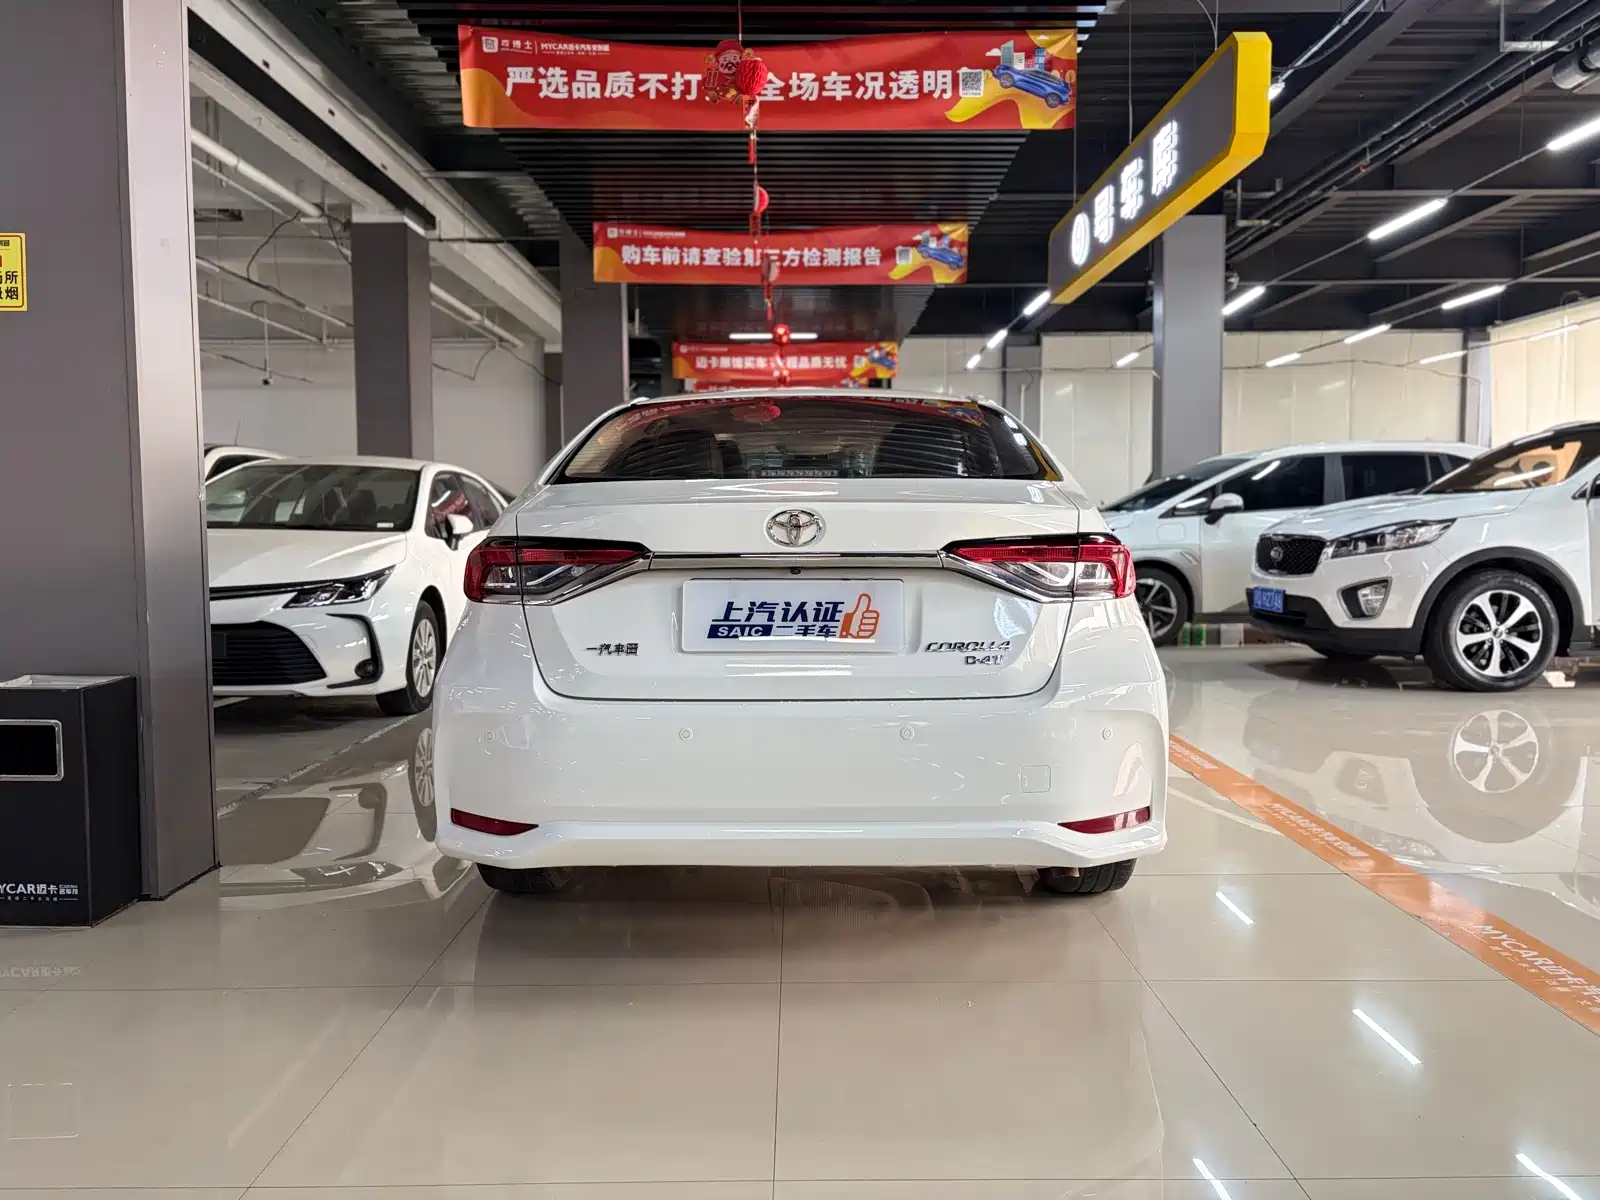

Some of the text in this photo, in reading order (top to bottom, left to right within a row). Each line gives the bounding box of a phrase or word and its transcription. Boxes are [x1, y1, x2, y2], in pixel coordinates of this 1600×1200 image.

[505, 66, 703, 101] 严选品质不打
[756, 68, 953, 102] 全场车况透明
[712, 601, 845, 623] 上汽认证
[717, 624, 839, 638] SAIC 二手车
[925, 640, 1010, 653] COROLLA
